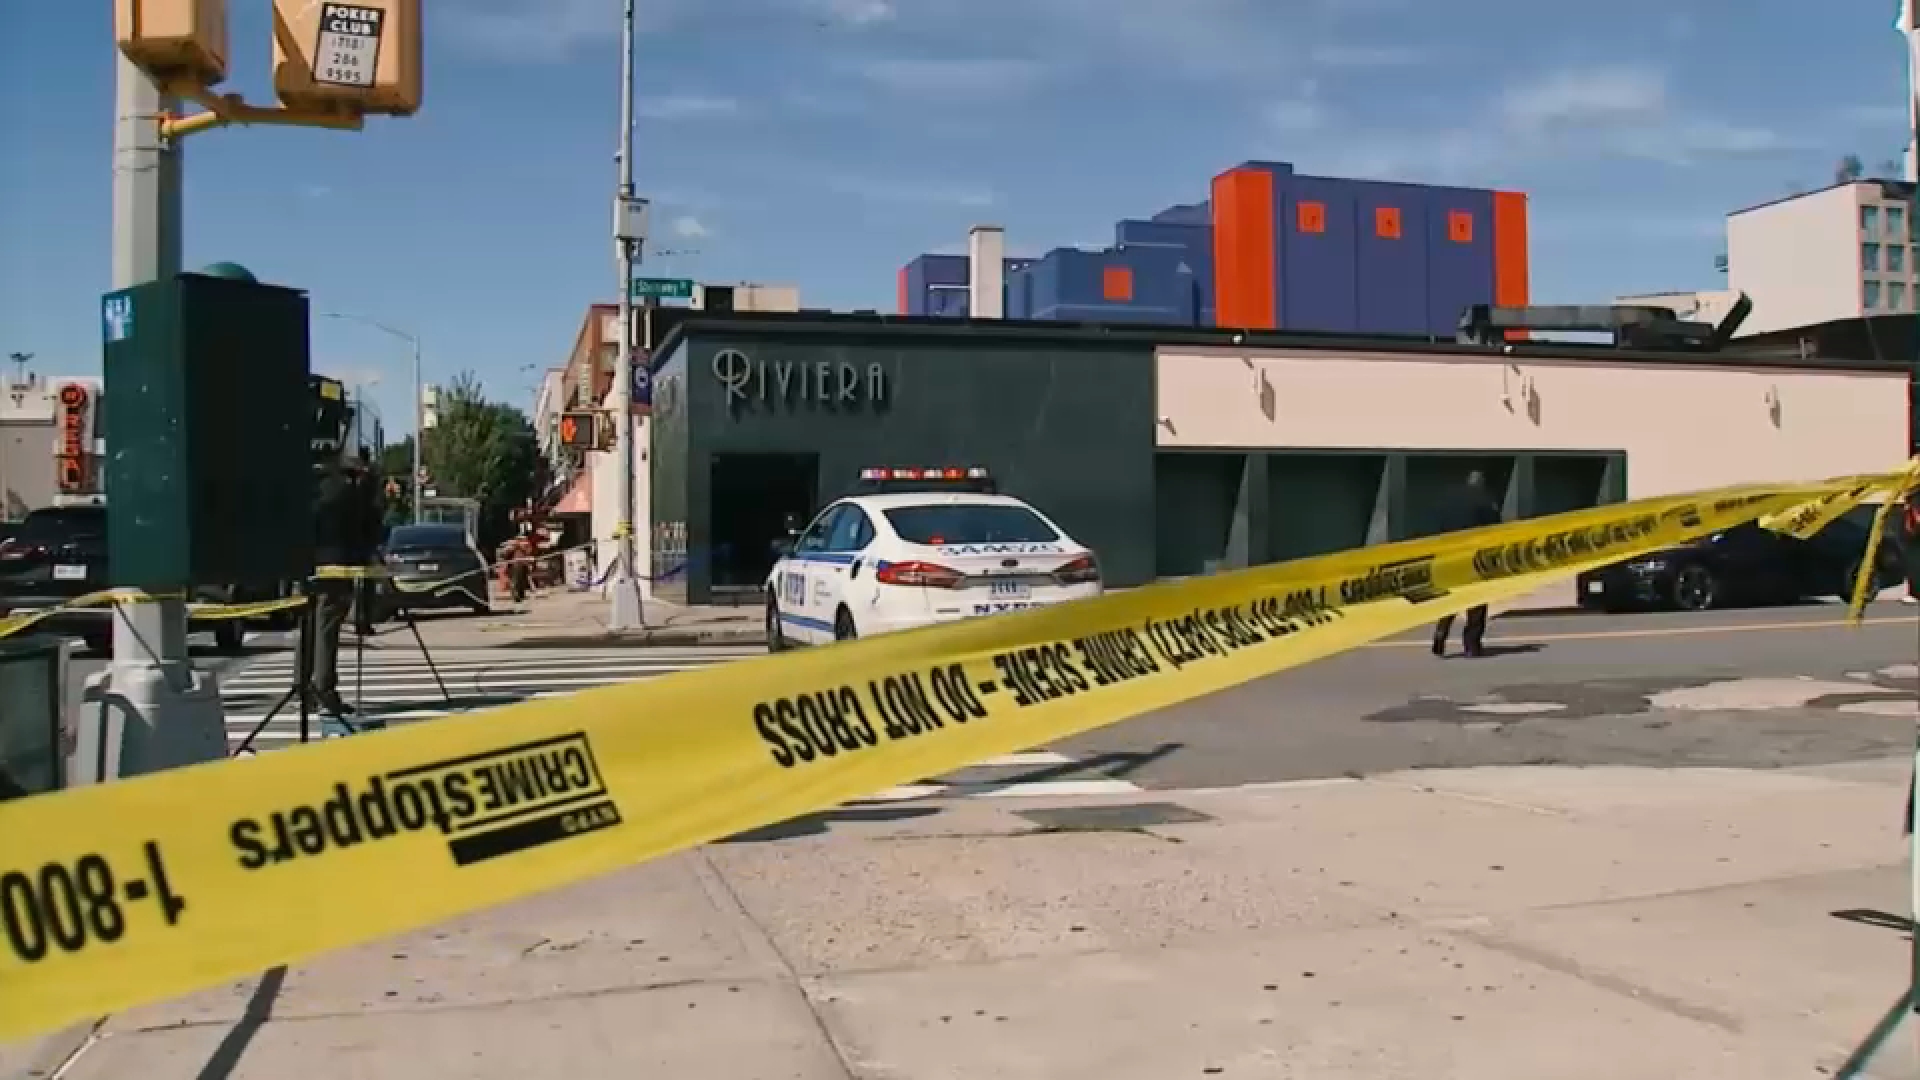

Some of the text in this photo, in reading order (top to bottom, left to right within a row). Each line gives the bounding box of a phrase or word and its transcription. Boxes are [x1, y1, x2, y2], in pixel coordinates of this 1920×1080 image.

[326, 5, 379, 22] POKER
[330, 20, 371, 35] CLUB
[712, 348, 883, 405] RIVIERA
[992, 642, 1090, 707] SCENE
[1074, 627, 1160, 687] CRIME
[868, 672, 945, 740] NOT
[930, 663, 988, 724] DO
[753, 686, 879, 769] CROSS
